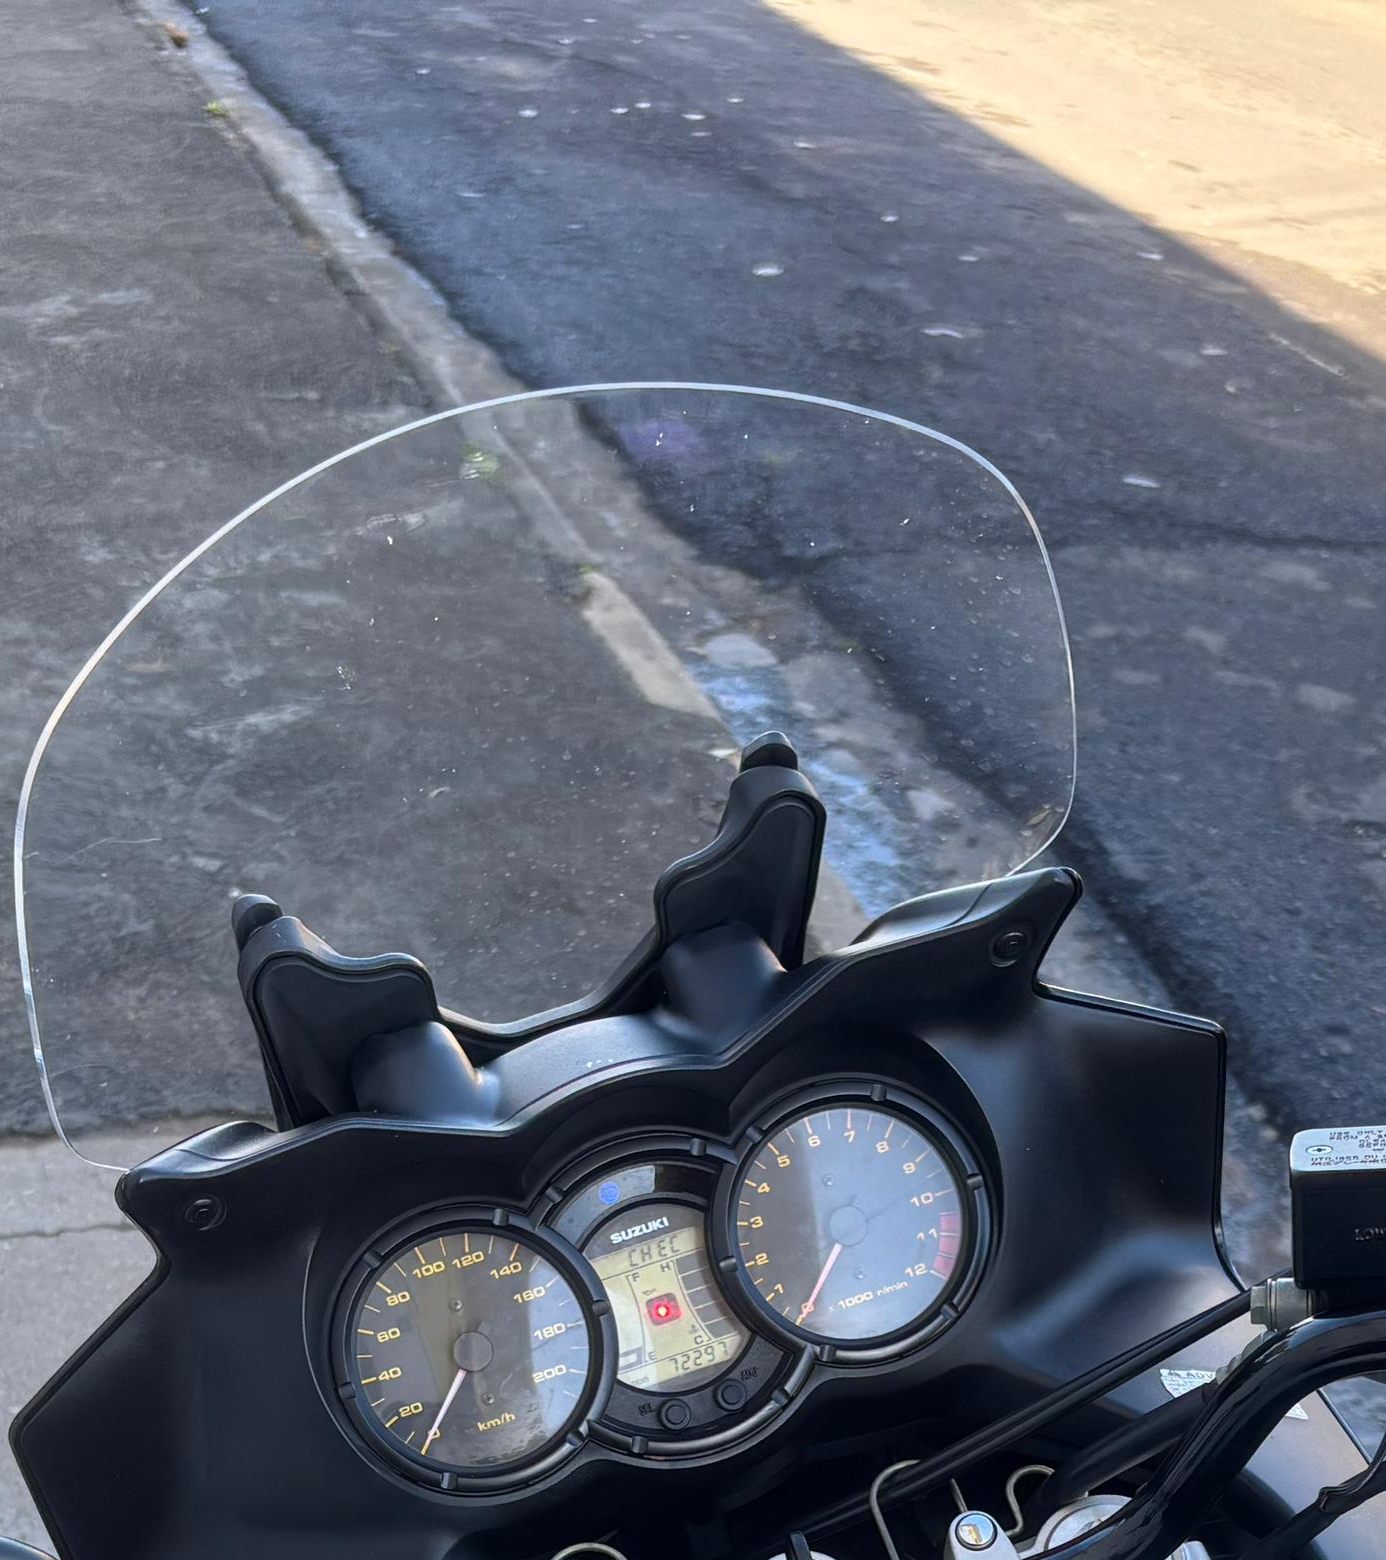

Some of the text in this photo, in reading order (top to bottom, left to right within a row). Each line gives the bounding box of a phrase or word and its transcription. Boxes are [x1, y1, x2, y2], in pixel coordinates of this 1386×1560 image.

[808, 1135, 821, 1147] 6
[844, 1130, 856, 1143] 7
[875, 1141, 890, 1153] 8
[776, 1155, 791, 1168] 5
[902, 1162, 917, 1174] 9
[757, 1182, 770, 1194] 4
[910, 1192, 934, 1207] 10
[610, 1216, 670, 1245] SUZUKI
[749, 1216, 764, 1229] 3
[916, 1228, 939, 1242] 11
[452, 1251, 485, 1269] 120
[755, 1253, 770, 1266] 2
[412, 1261, 446, 1279] 100
[489, 1262, 523, 1280] 140
[904, 1263, 928, 1278] 12
[513, 1286, 546, 1304] 160
[773, 1283, 785, 1295] 1
[838, 1291, 874, 1309] 1000
[876, 1281, 908, 1297] r/min
[385, 1291, 411, 1307] 80
[376, 1327, 401, 1343] 60
[533, 1323, 567, 1341] 180
[669, 1341, 728, 1372] 72297
[377, 1366, 402, 1382] 40
[532, 1364, 568, 1384] 200
[398, 1402, 423, 1418] 20
[477, 1412, 516, 1432] km/h
